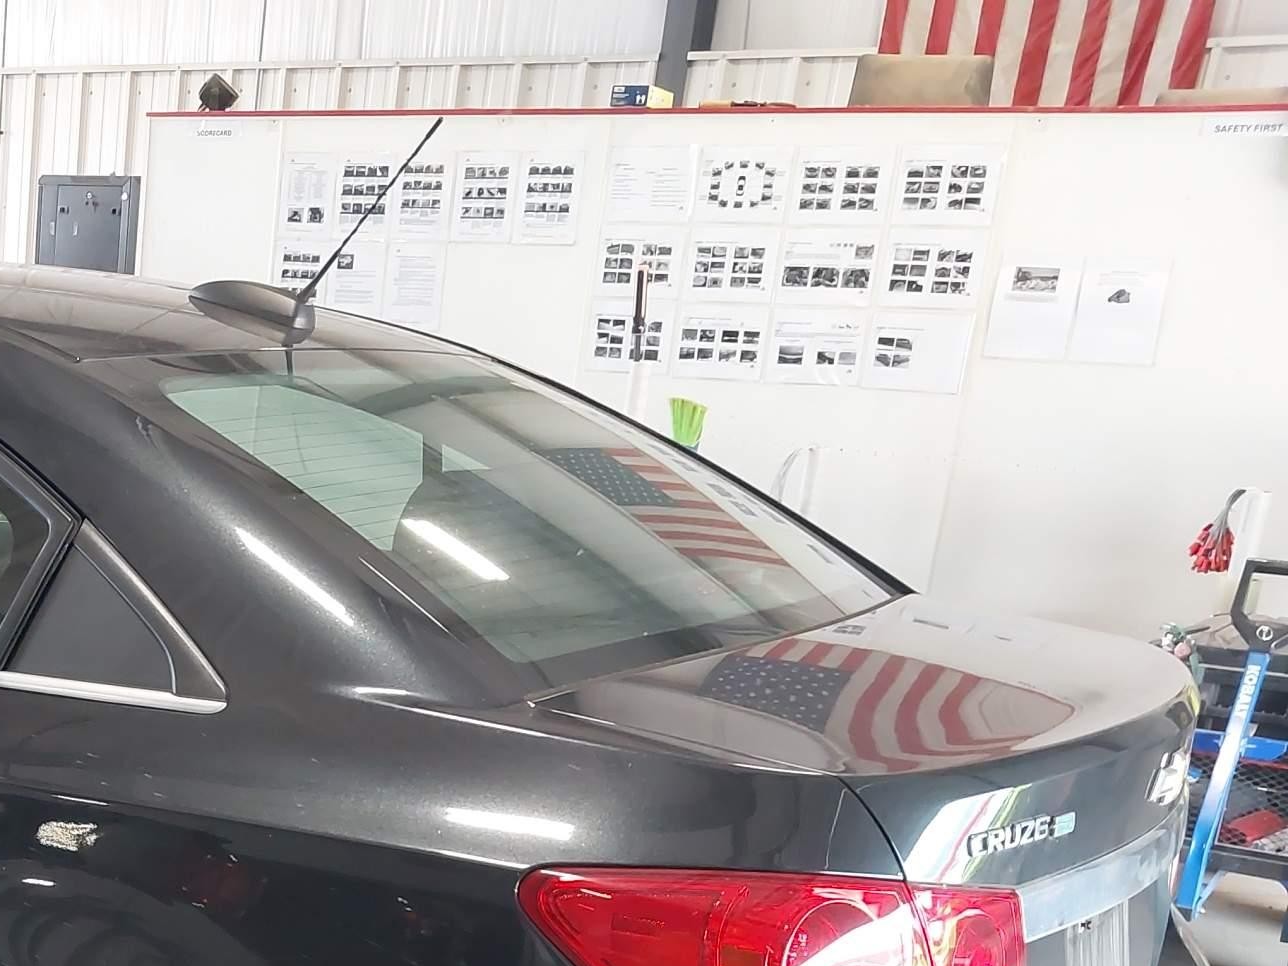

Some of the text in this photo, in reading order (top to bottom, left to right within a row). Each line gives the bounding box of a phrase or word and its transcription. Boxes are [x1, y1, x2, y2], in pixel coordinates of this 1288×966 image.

[1215, 123, 1283, 133] SAFETY FIRST
[1233, 664, 1262, 717] KOBALT
[968, 815, 1052, 857] CRUZE
